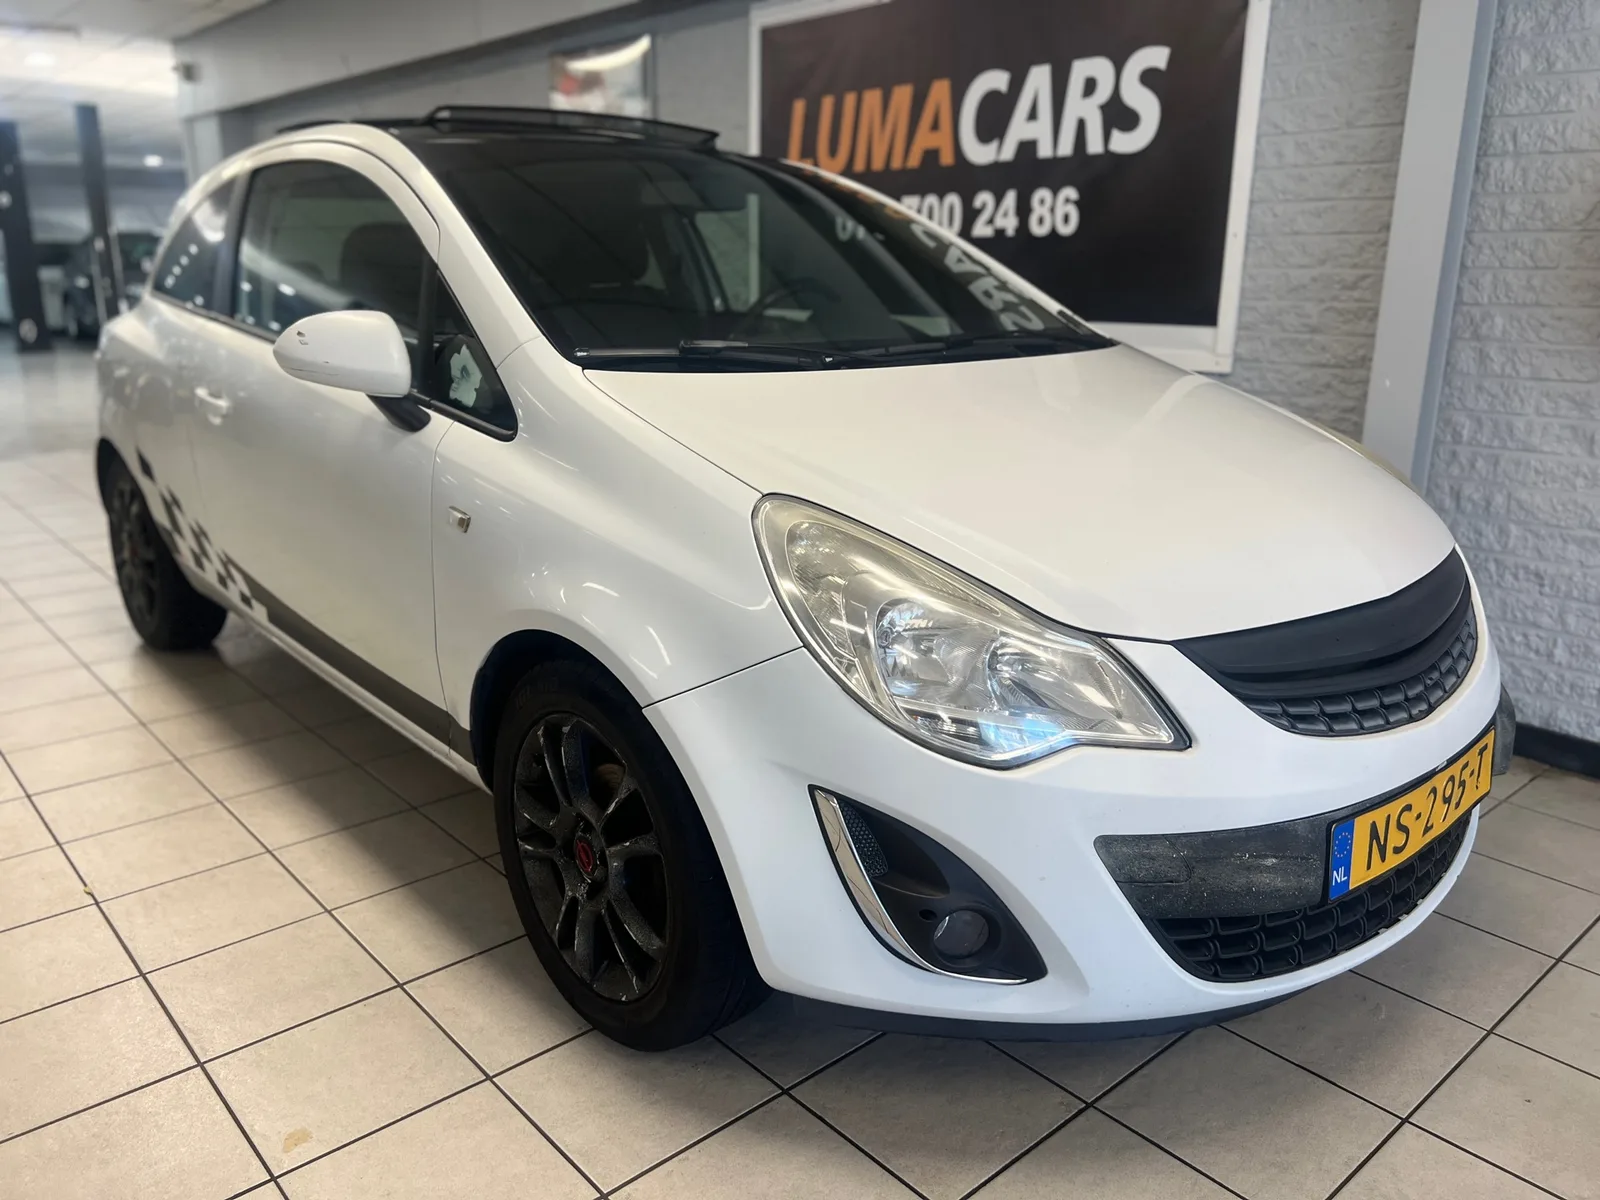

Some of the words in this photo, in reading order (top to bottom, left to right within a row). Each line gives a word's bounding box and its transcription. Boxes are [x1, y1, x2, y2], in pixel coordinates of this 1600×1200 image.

[787, 45, 1171, 175] LUMACARS
[970, 188, 1020, 238] 24
[1028, 185, 1080, 237] 86
[1366, 742, 1488, 871] NS-295-T
[1332, 866, 1348, 886] NL
